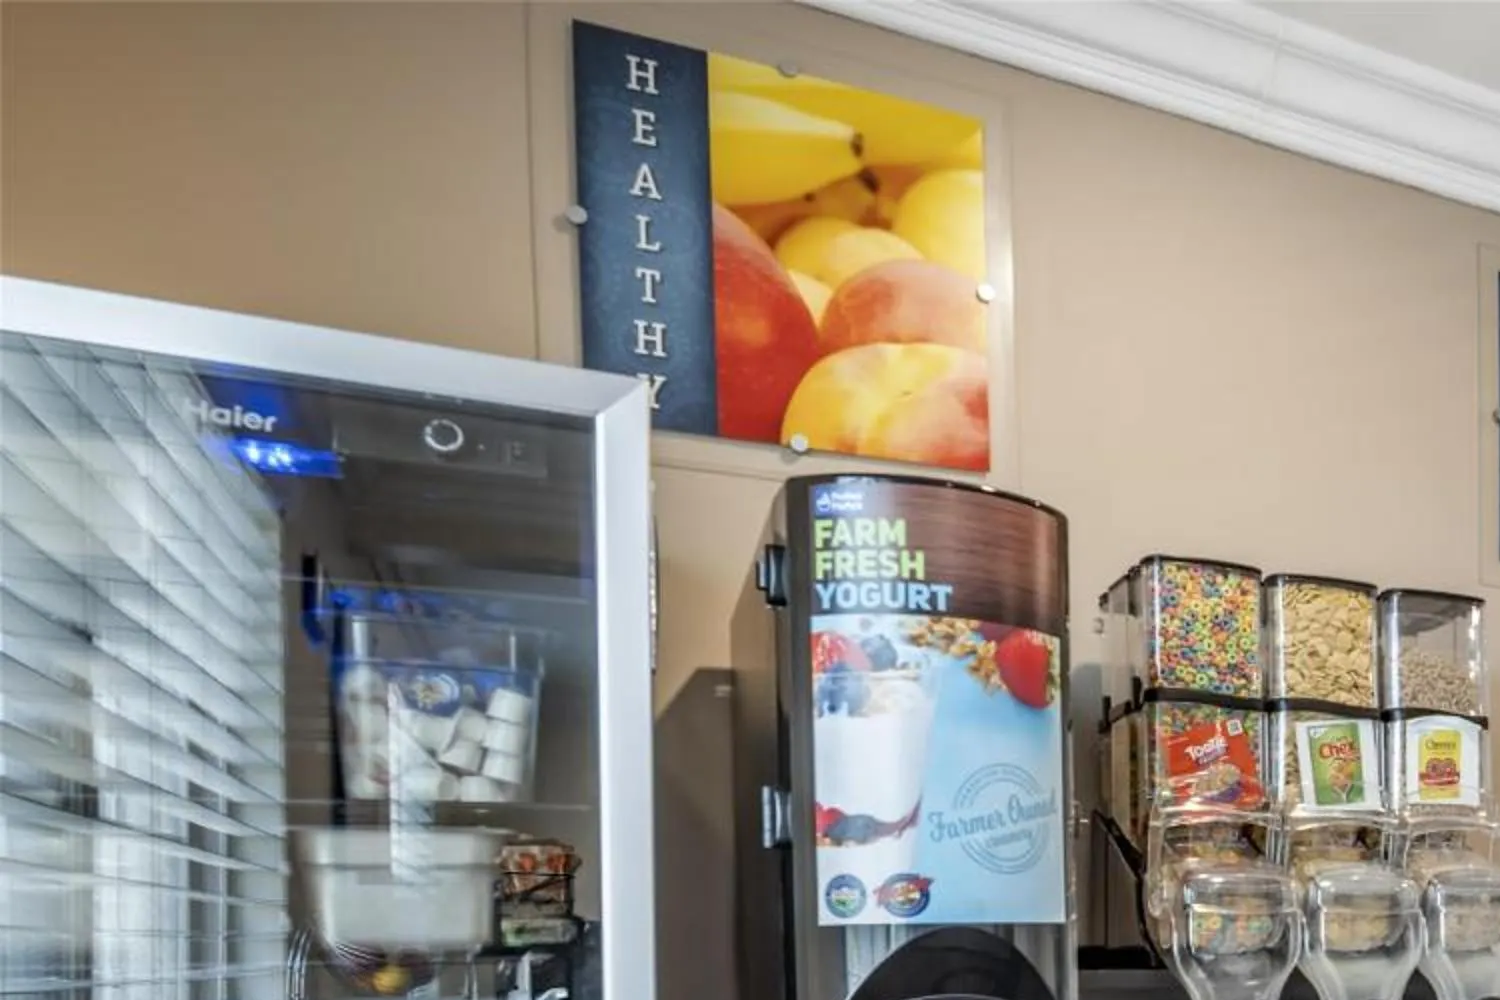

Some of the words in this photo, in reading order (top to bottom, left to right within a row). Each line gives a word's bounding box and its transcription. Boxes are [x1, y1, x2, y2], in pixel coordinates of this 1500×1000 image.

[625, 53, 668, 410] HEALTHY
[185, 401, 279, 433] Haier
[814, 517, 906, 548] FARM
[816, 549, 925, 580] FRESH
[814, 581, 953, 612] YOGURT
[927, 809, 1006, 843] Farmer
